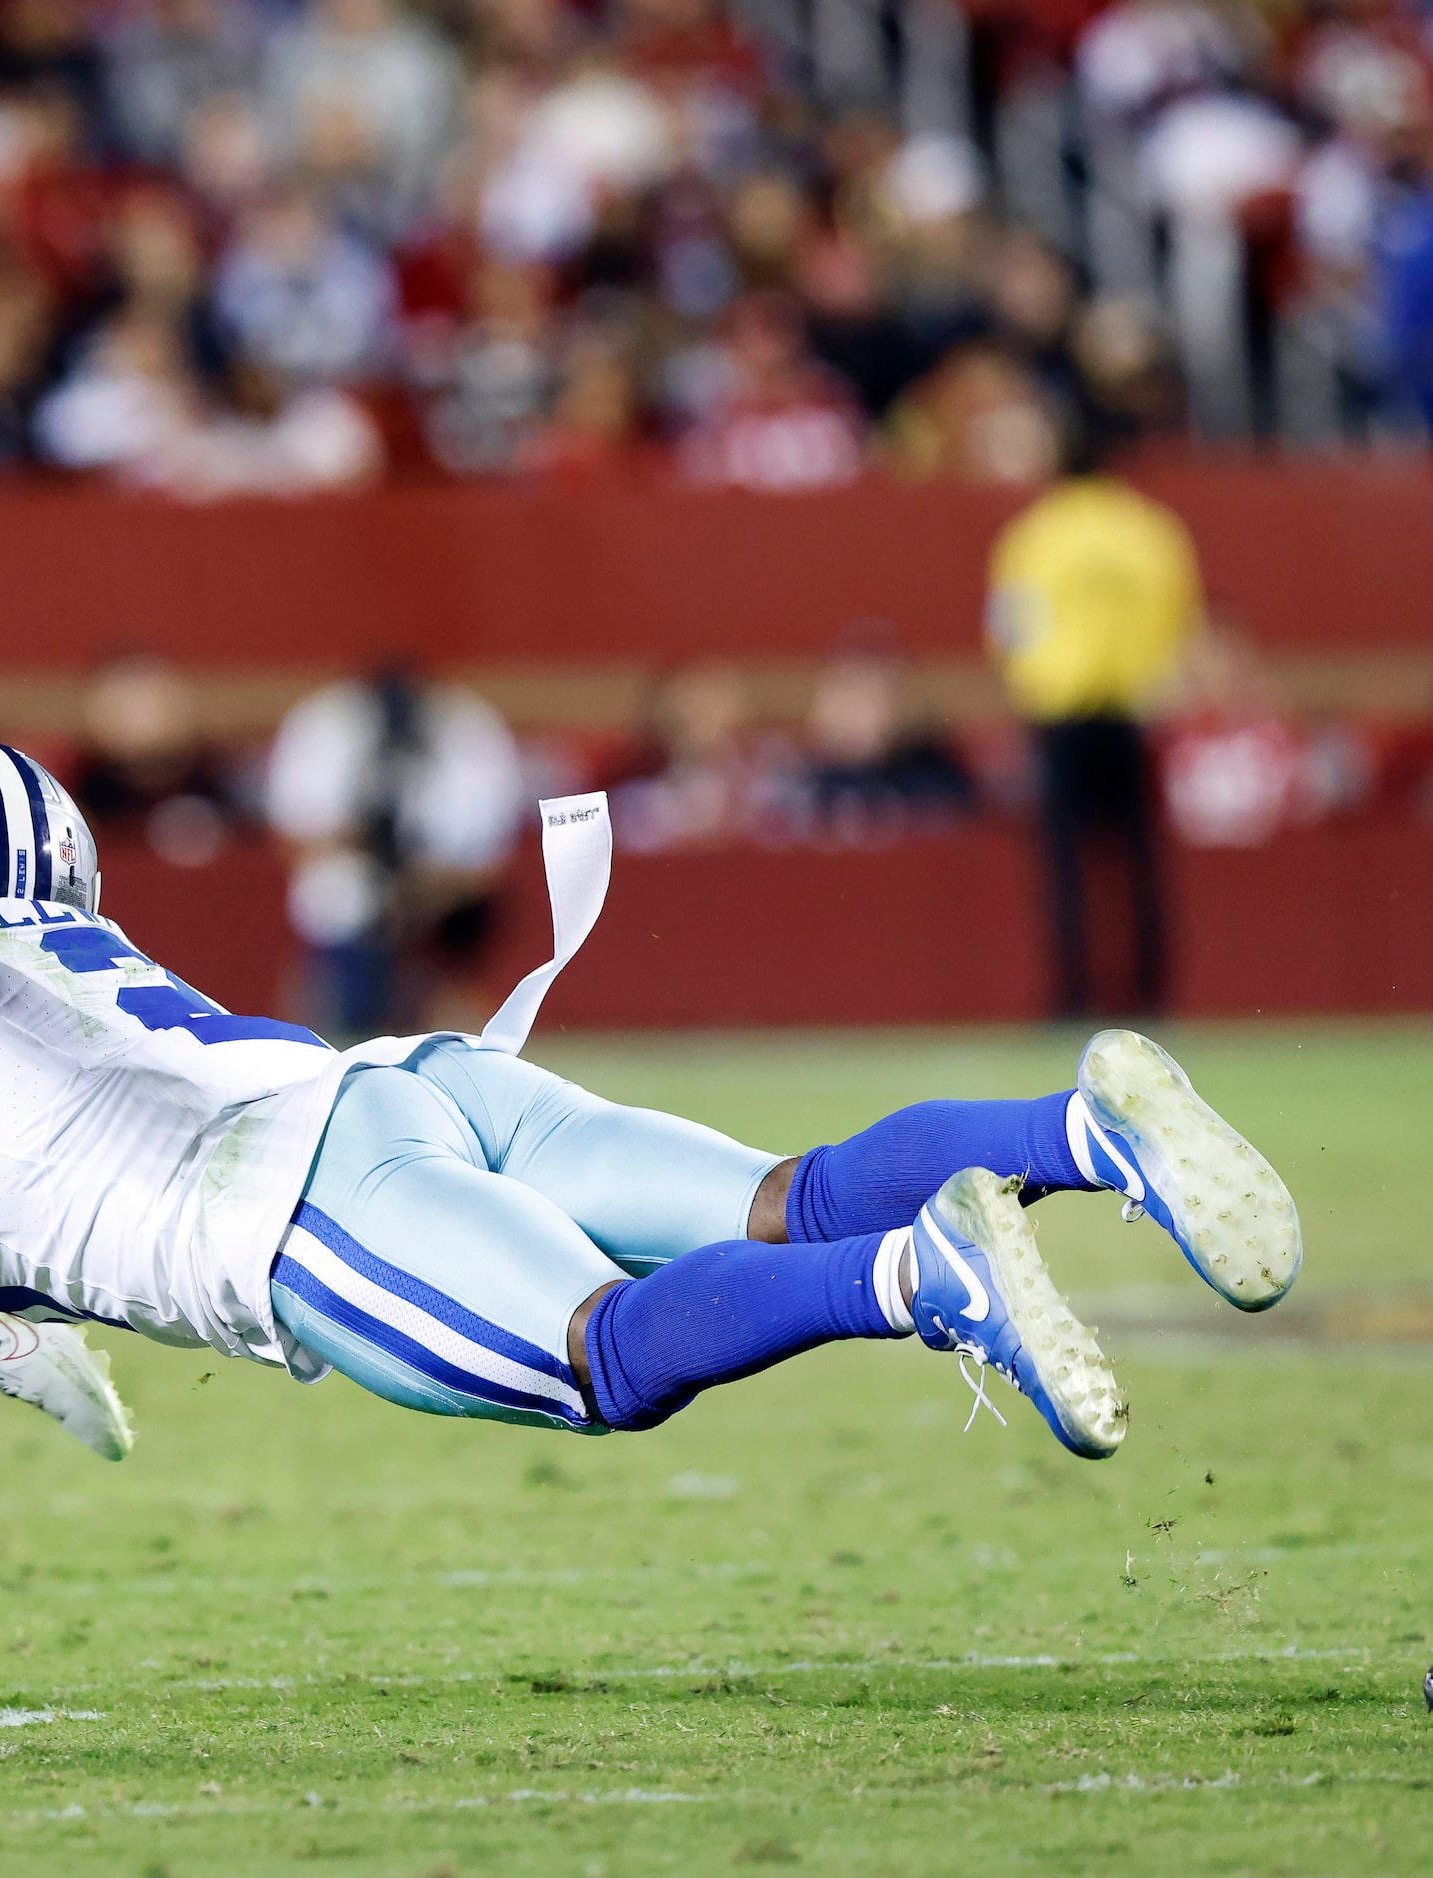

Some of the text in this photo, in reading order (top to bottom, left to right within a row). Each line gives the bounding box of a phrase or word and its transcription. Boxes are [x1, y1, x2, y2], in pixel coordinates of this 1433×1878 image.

[61, 846, 76, 863] NFL
[16, 850, 27, 895] 2 LEWIS
